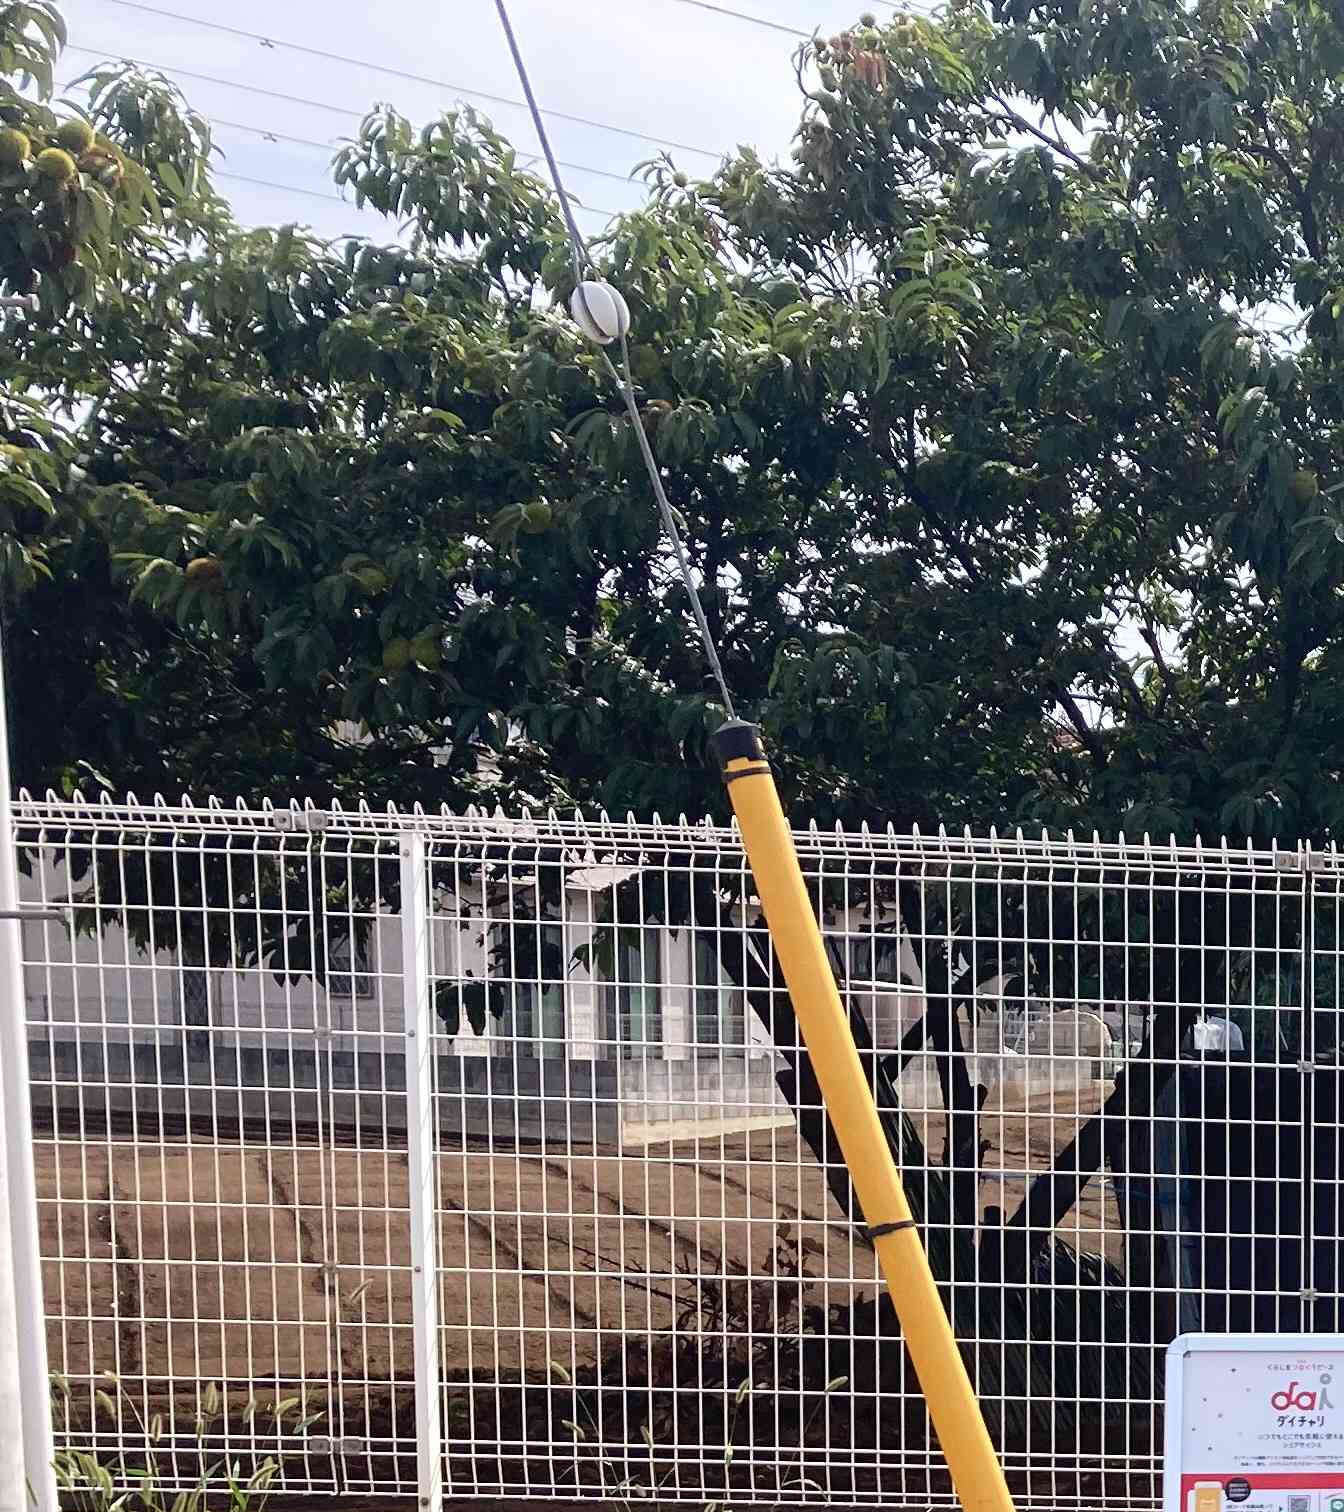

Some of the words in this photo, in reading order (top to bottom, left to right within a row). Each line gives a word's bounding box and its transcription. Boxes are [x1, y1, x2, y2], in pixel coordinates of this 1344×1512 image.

[1276, 1415, 1325, 1428] ダイチャリ
